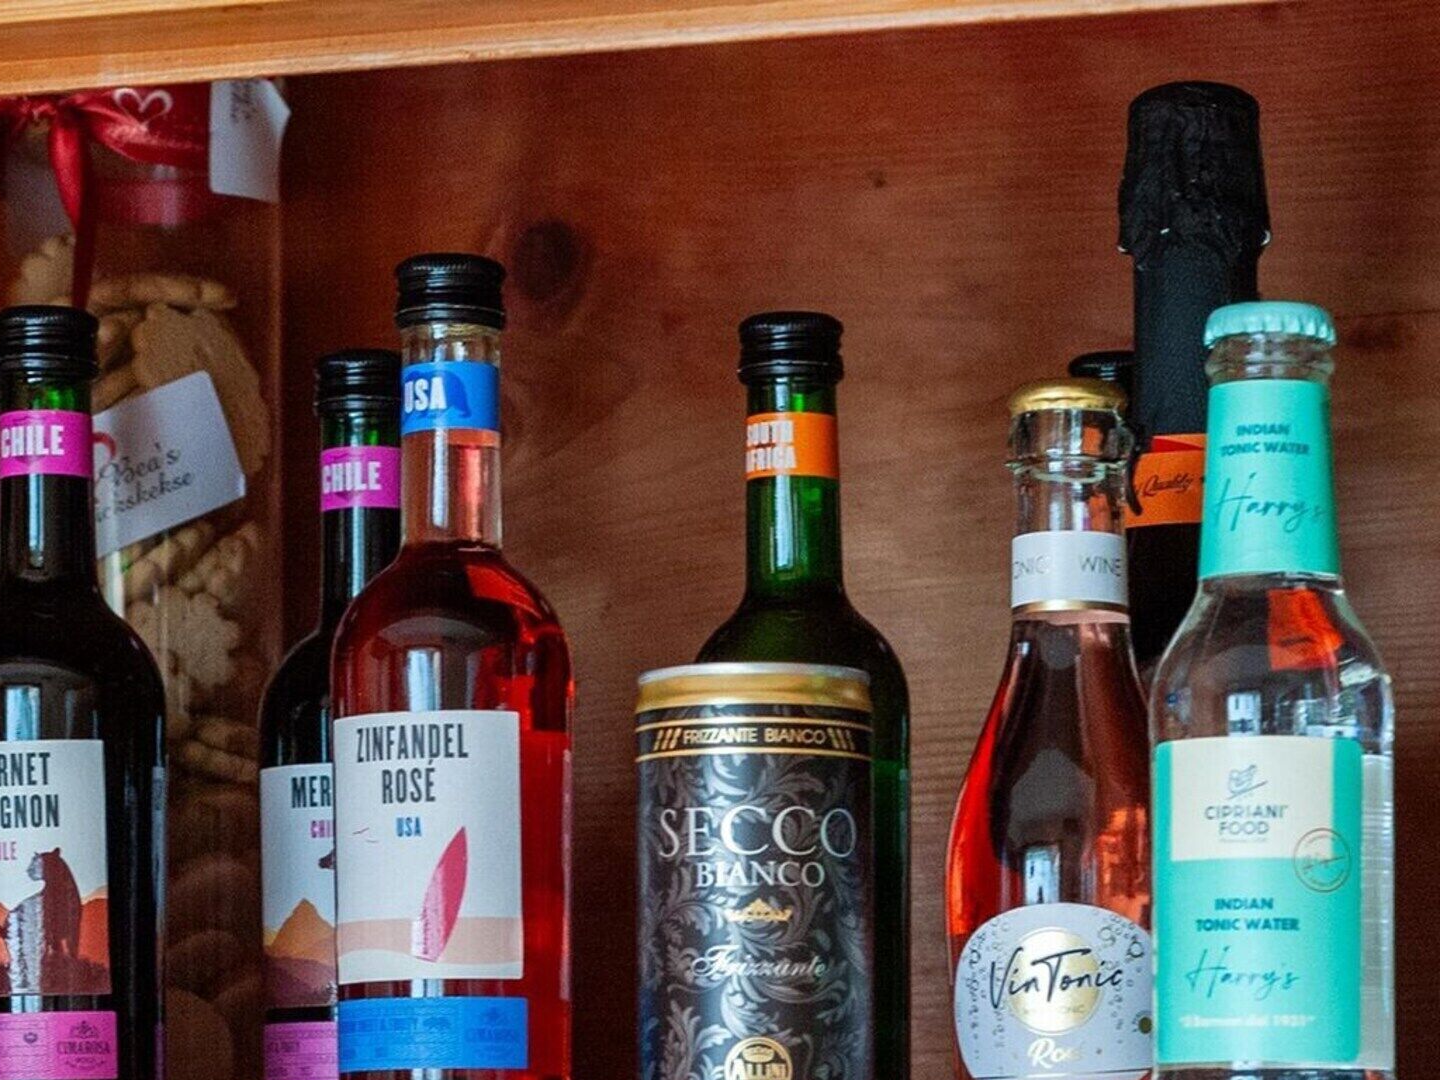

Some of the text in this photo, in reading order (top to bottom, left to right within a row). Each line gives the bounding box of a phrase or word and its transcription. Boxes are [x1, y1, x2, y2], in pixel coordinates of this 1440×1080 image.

[1236, 424, 1291, 436] INDIAN
[1, 424, 65, 458] CHILE
[1220, 443, 1310, 457] TONIC WATER
[322, 461, 382, 494] CHILE
[1080, 556, 1121, 577] WINE
[356, 723, 469, 763] ZINFANDEL
[682, 728, 826, 744] FRIZZANTE BIANCO
[382, 758, 436, 804] ROSÉ
[396, 817, 423, 837] USA
[659, 805, 857, 858] SECCO
[1219, 821, 1269, 836] FOOD
[695, 861, 826, 888] BIANCO
[1215, 898, 1274, 910] INDIAN
[1196, 917, 1301, 932] TONIC WATER
